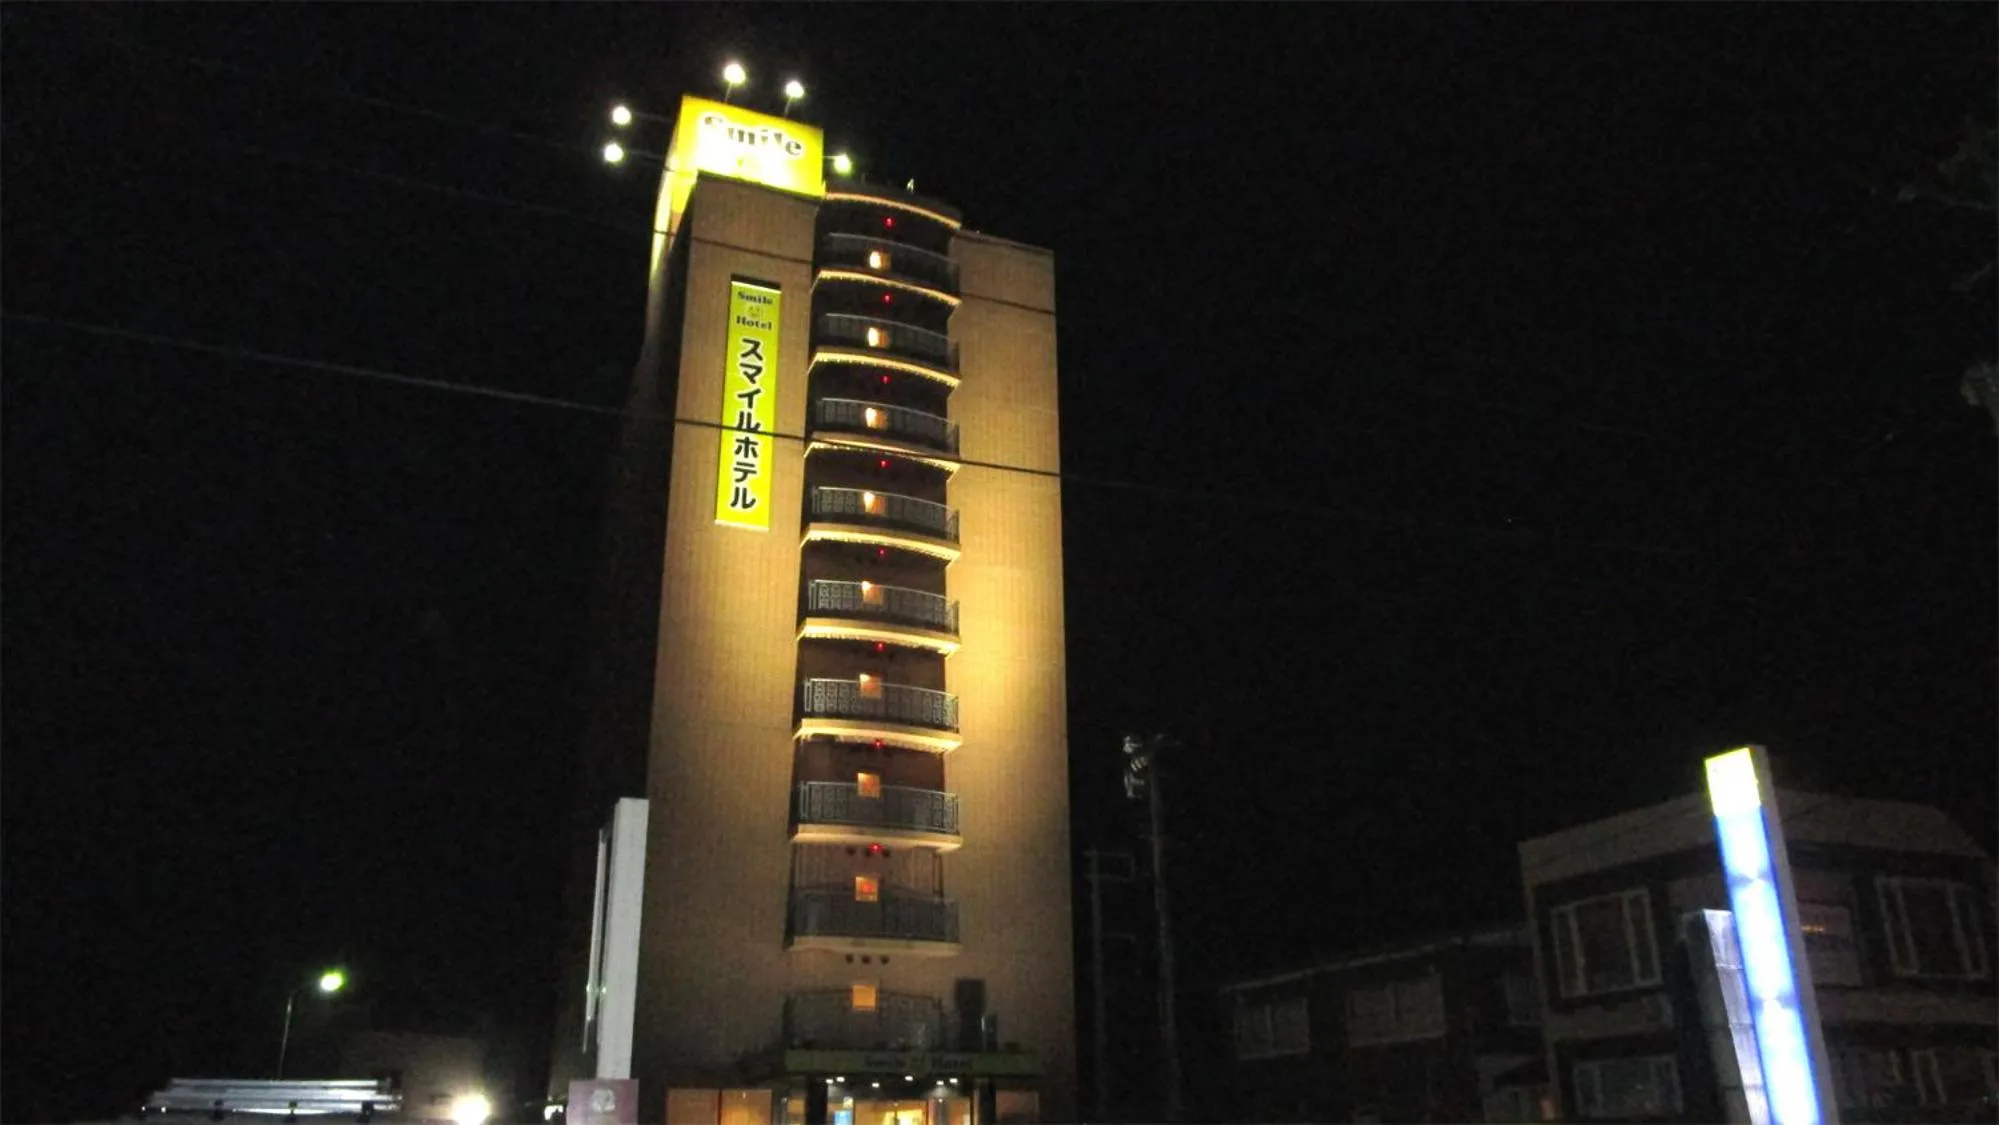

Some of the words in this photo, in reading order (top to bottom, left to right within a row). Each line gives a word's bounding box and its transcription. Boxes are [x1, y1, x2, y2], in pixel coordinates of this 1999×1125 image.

[738, 291, 773, 305] Smile
[736, 315, 772, 331] Hotel
[730, 338, 764, 510] スマイルホテル
